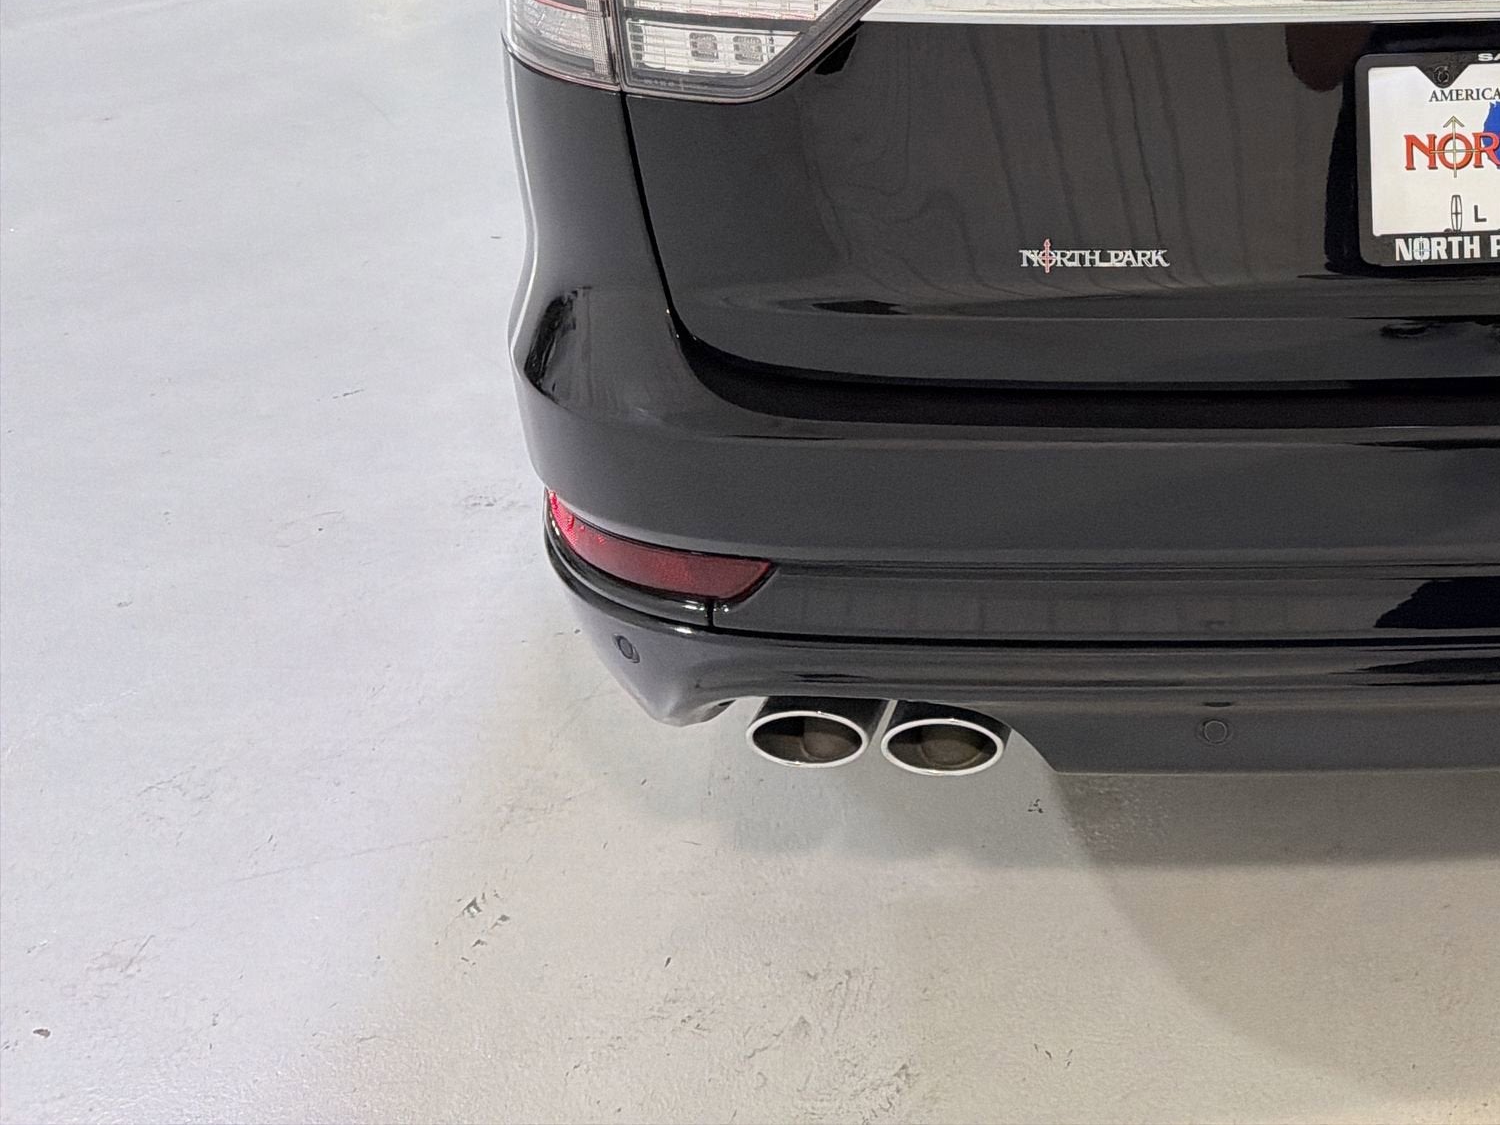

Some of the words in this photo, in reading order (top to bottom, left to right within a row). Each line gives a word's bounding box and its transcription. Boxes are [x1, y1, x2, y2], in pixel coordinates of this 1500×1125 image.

[1018, 248, 1101, 269] NORTH
[1107, 249, 1171, 268] PARK
[1395, 235, 1481, 262] NORTH
